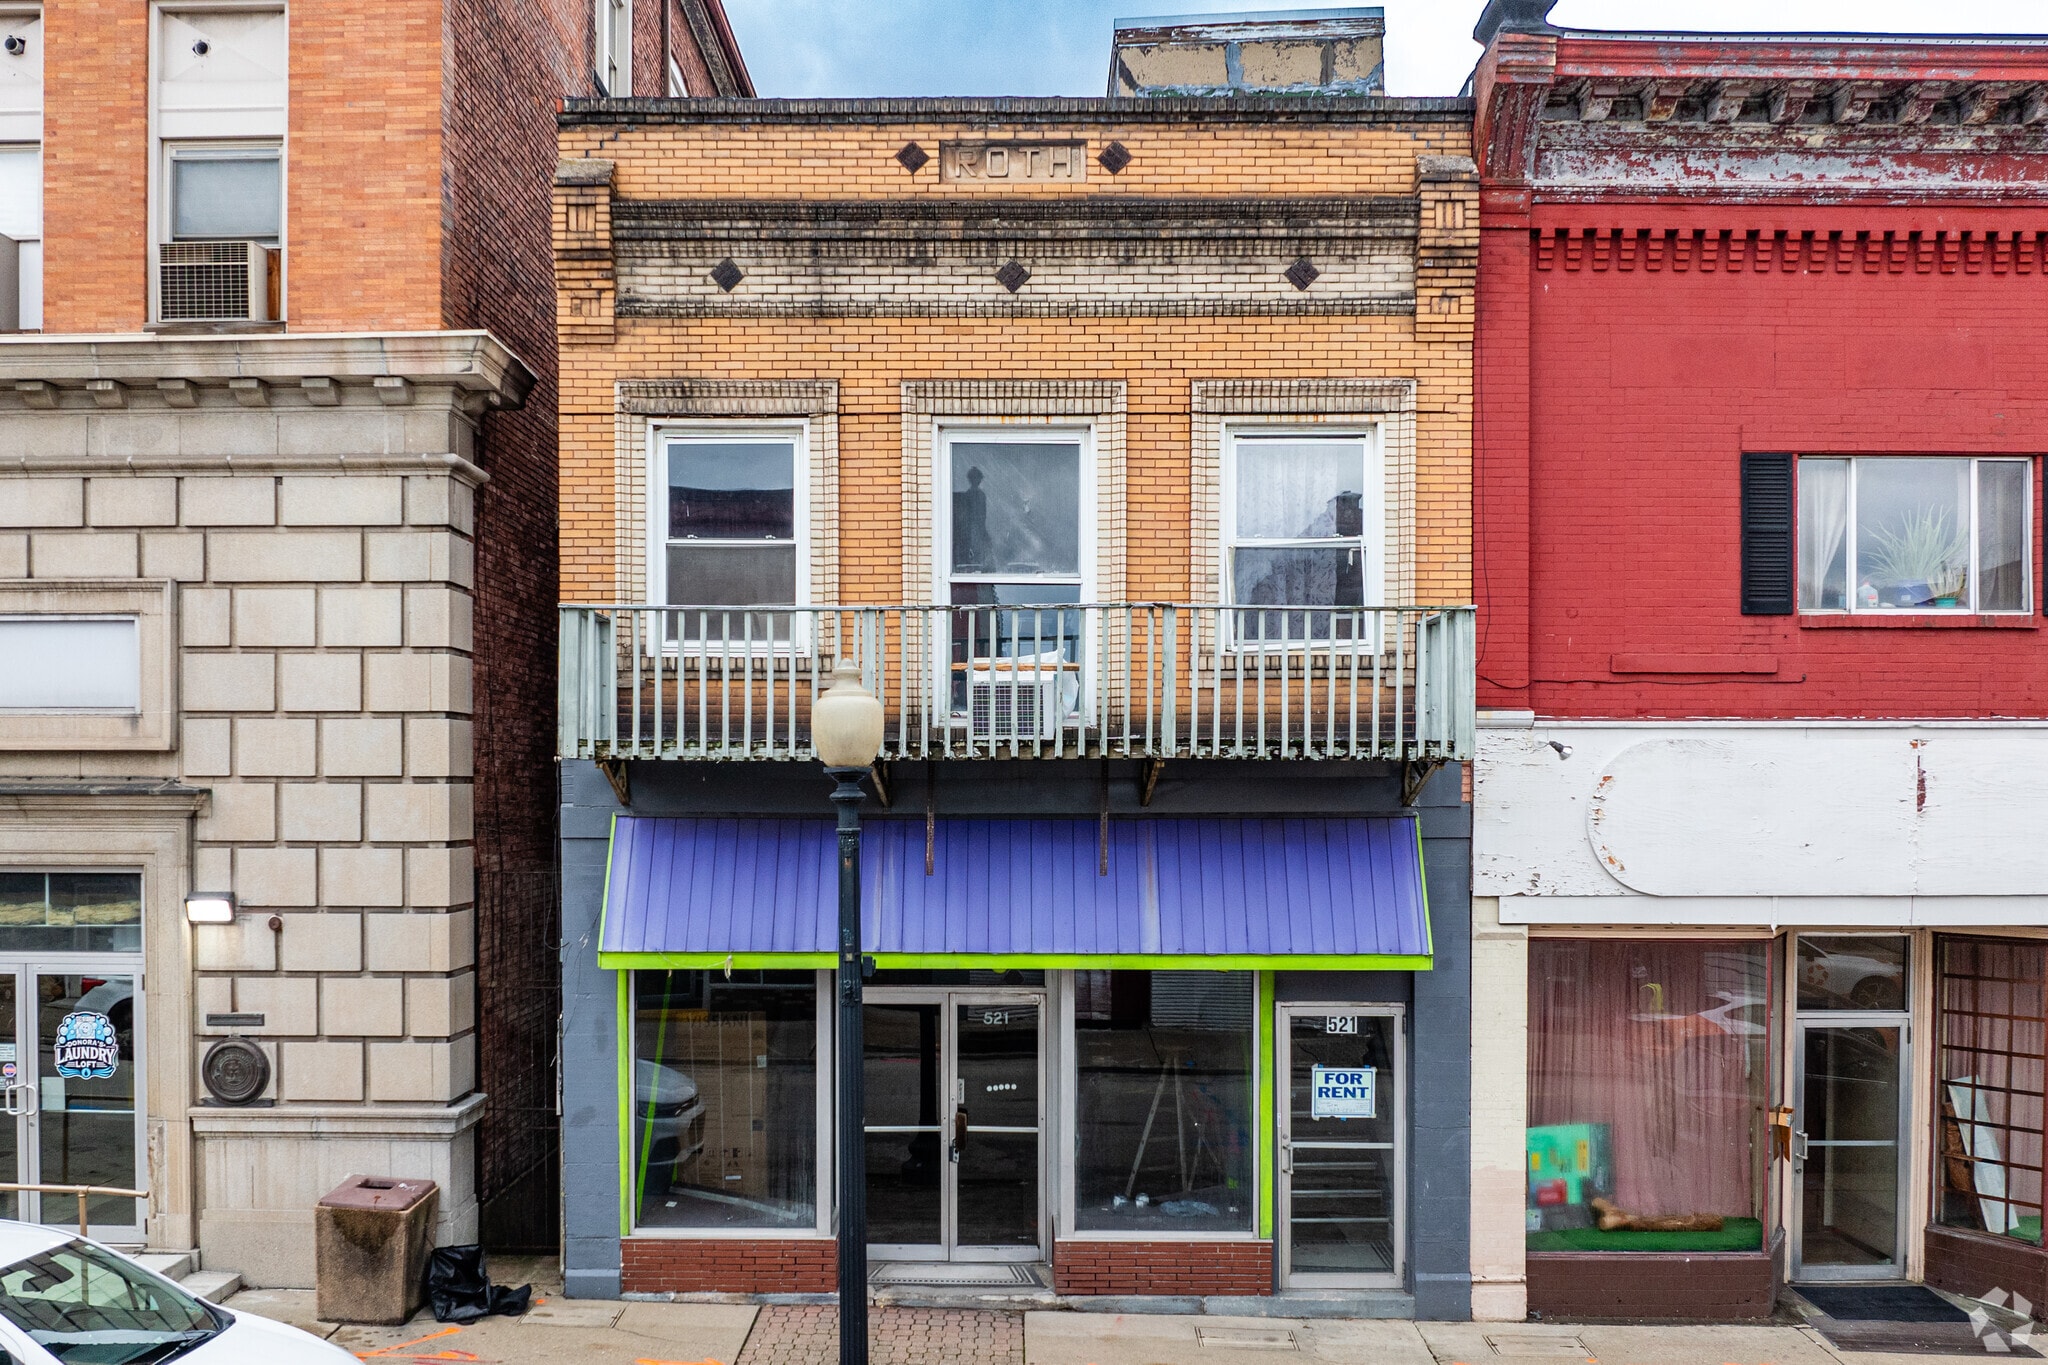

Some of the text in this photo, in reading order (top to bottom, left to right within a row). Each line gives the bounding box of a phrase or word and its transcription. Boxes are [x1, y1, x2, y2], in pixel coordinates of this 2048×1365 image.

[954, 146, 1073, 178] ROTH
[983, 1011, 1009, 1025] 521
[1328, 1016, 1357, 1033] 521
[57, 1046, 116, 1066] LAUNDRY
[75, 1060, 97, 1068] LOFT
[1324, 1073, 1363, 1085] FOR
[1318, 1086, 1369, 1099] RENT
